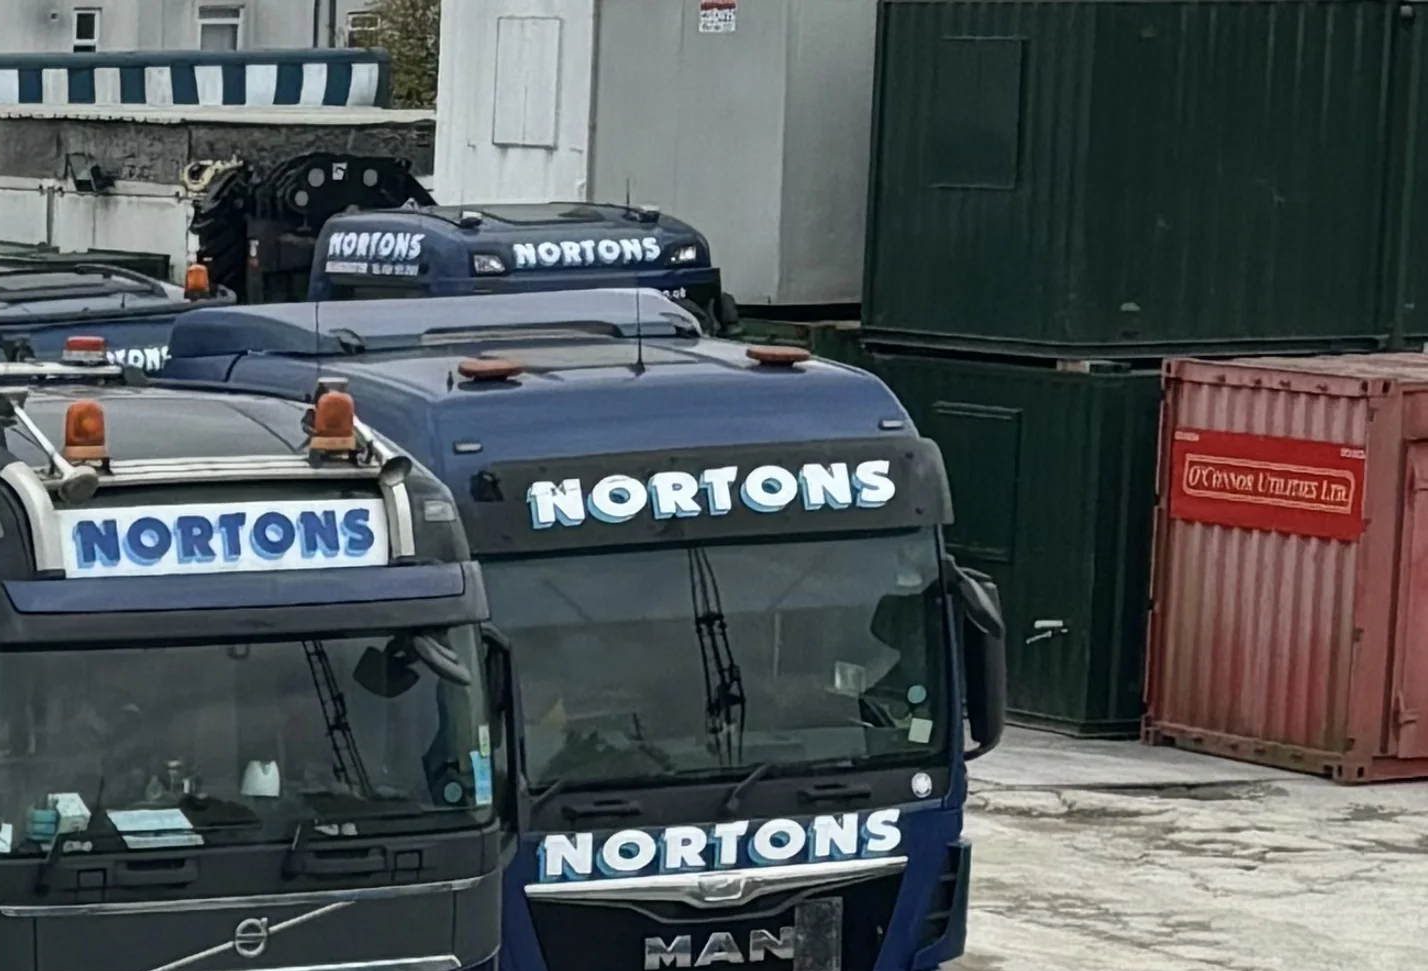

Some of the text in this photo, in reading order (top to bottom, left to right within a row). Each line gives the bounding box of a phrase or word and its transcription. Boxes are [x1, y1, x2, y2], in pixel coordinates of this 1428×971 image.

[329, 231, 425, 261] NORTONS
[512, 237, 661, 268] NORTONS
[527, 459, 896, 530] NORTONS
[73, 507, 375, 570] NORTONS
[537, 808, 901, 884] NORTONS
[644, 926, 796, 971] MAN
